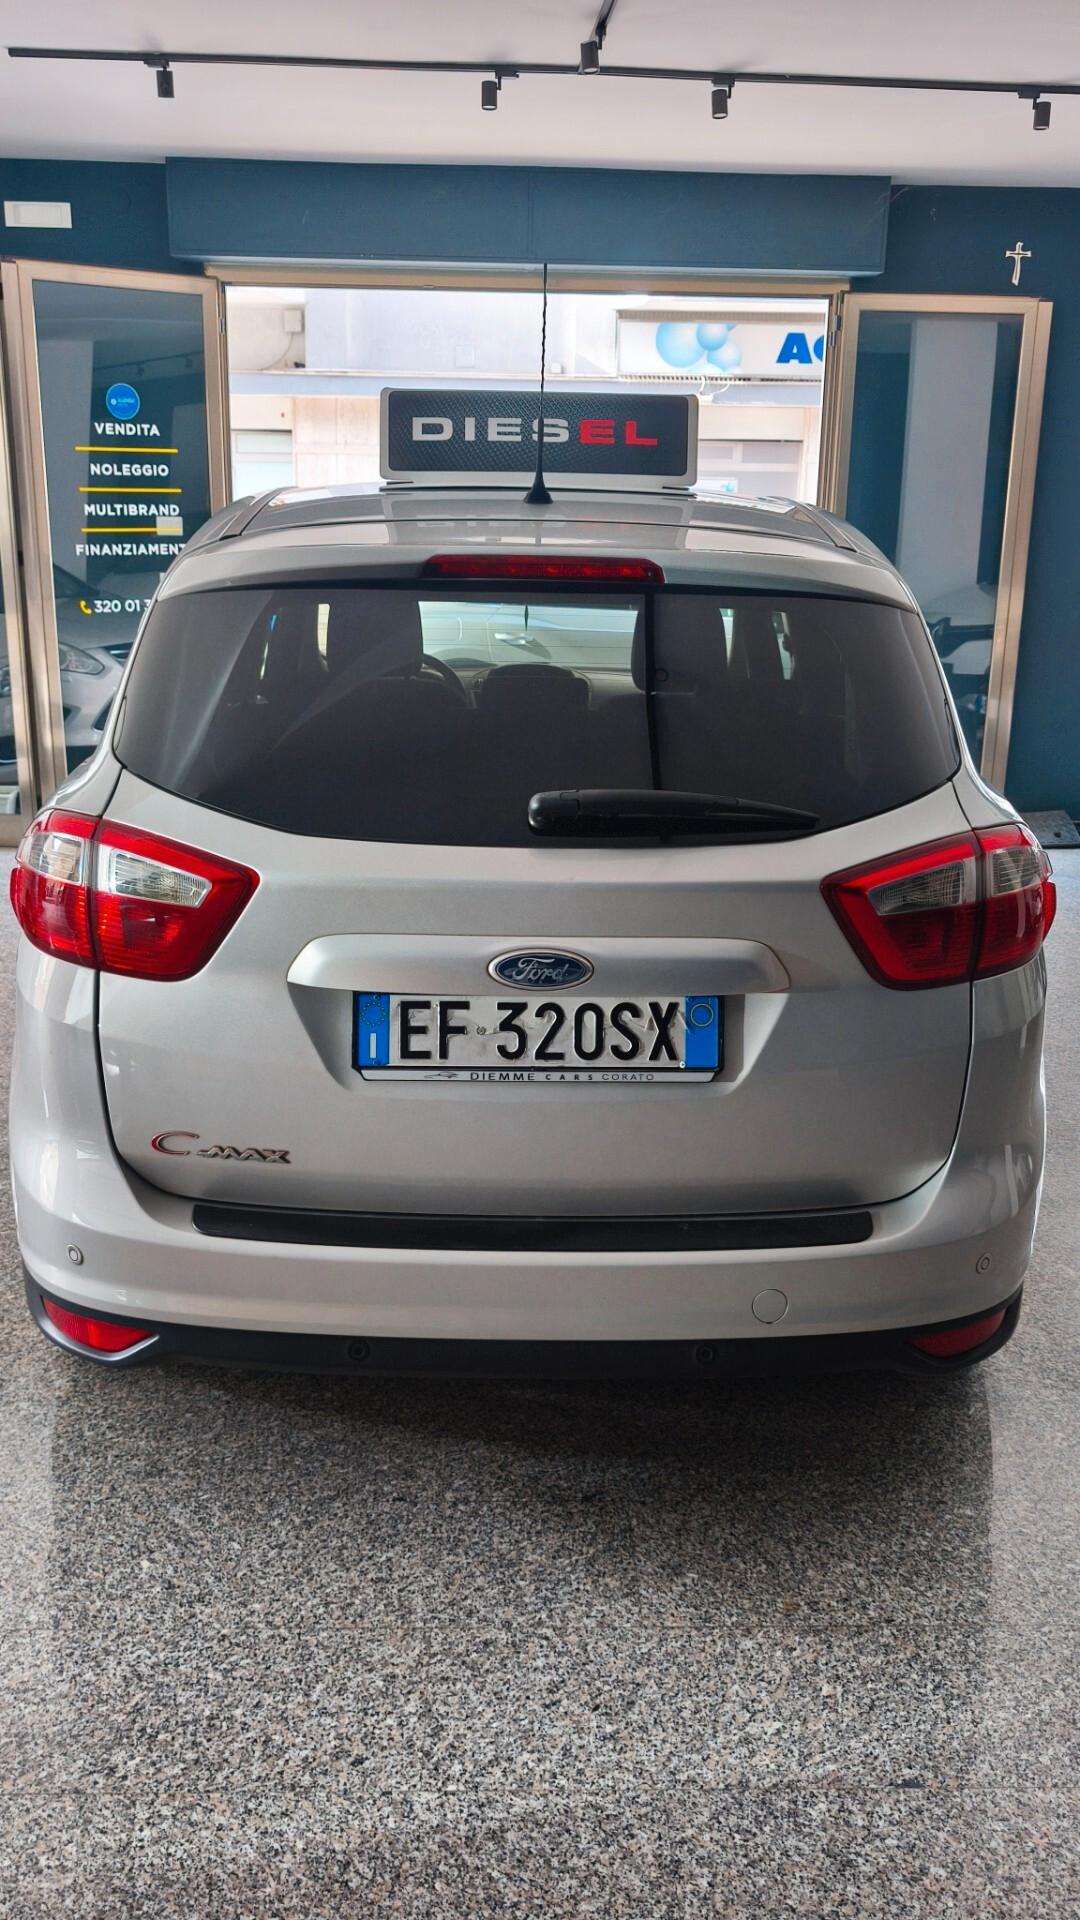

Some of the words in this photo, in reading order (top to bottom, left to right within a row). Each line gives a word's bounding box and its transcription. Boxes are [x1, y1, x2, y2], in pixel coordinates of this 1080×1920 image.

[94, 422, 160, 437] VENDITA
[411, 416, 658, 446] DIESEL
[90, 463, 169, 477] NOLEGGIO
[84, 503, 180, 517] MULTIBRAND
[94, 599, 121, 613] 320
[125, 599, 141, 613] 01
[513, 957, 569, 981] Ford
[400, 1000, 470, 1060] EF
[496, 1001, 680, 1061] 320SX
[470, 1072, 535, 1081] DIEMME
[602, 1073, 655, 1081] CORATO
